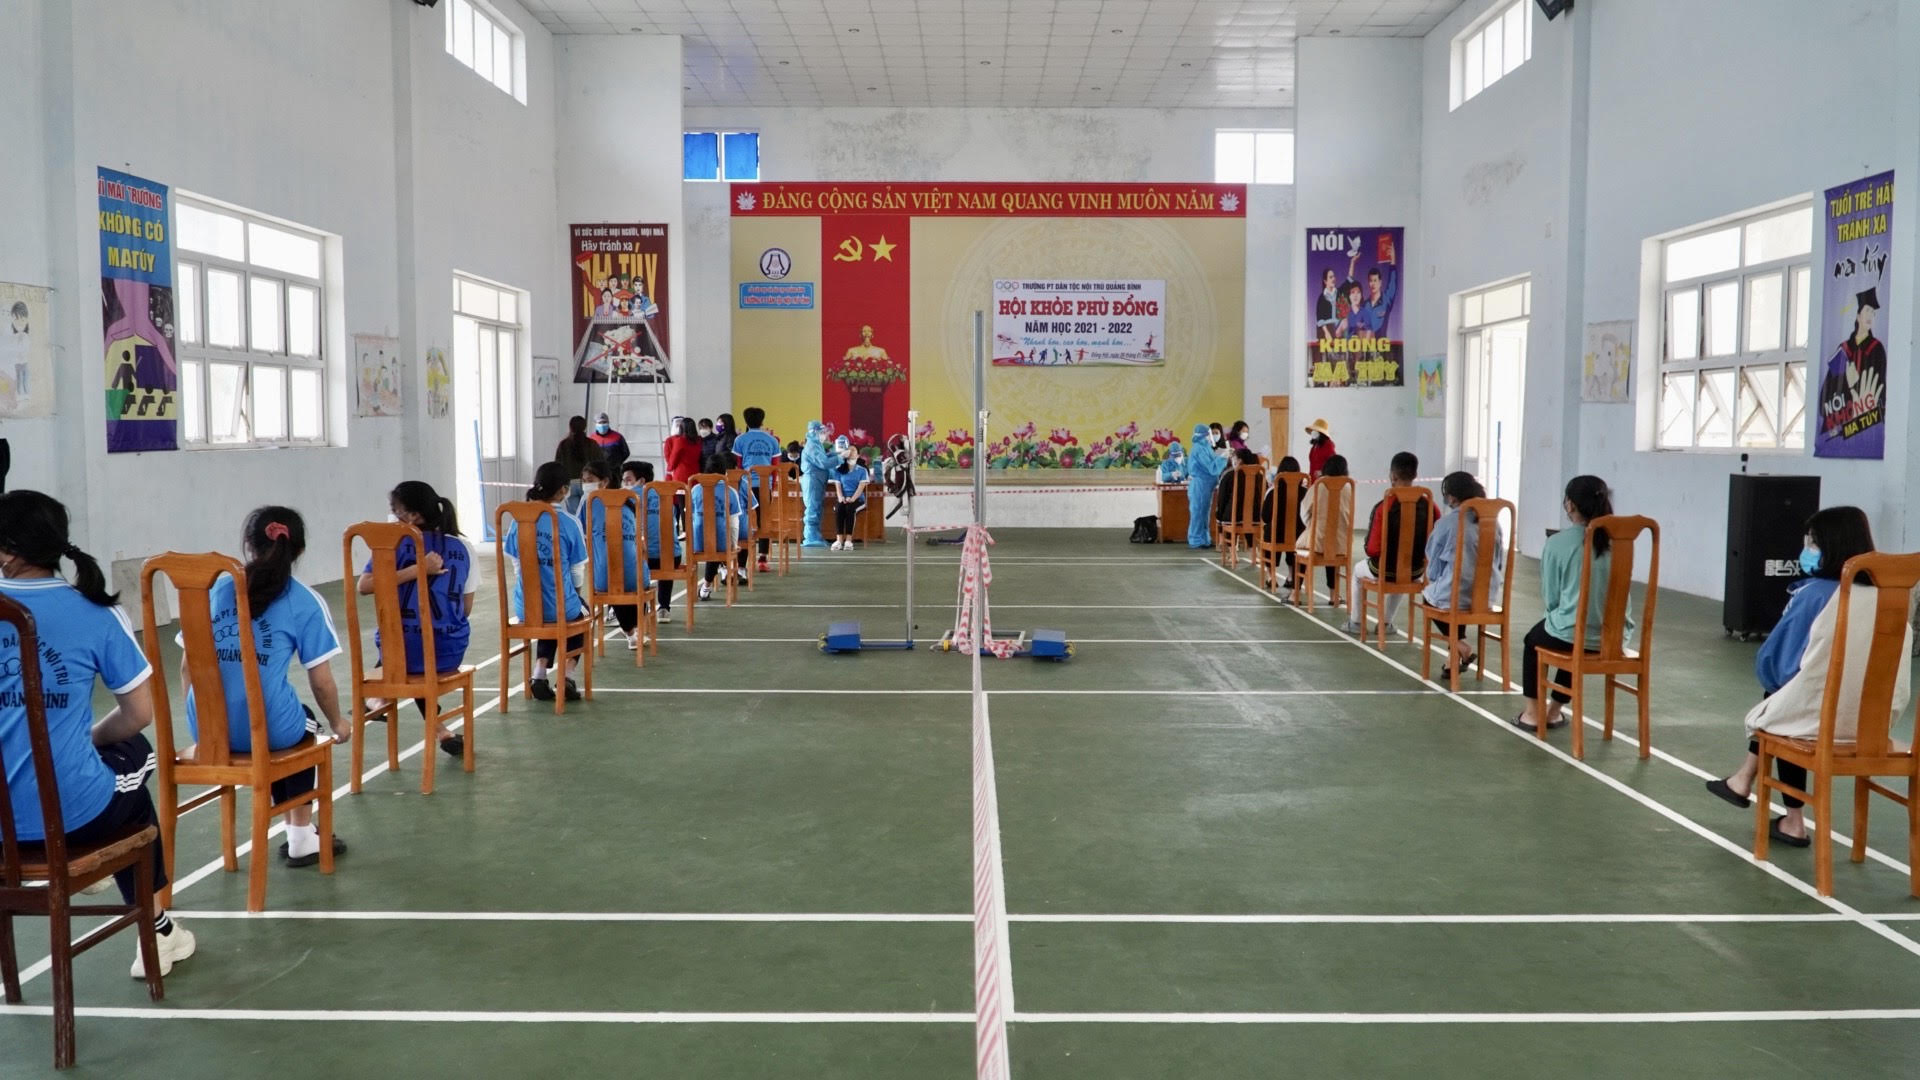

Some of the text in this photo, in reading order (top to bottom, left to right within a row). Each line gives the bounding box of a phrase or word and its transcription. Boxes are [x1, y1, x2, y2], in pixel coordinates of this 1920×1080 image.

[107, 180, 126, 201] MÁI
[762, 186, 1215, 213] ĐẢNG CỘNG SẢN VIỆT NAM QUANG VINH MUÔN NĂM
[1830, 188, 1852, 218] TUỔI
[1855, 183, 1873, 211] TRẺ
[99, 210, 164, 242] KHÔNG CÓ
[1837, 214, 1887, 243] TRÁNH XA
[581, 239, 633, 251] Hãy tránh xa
[1311, 230, 1344, 251] NÓI
[1834, 243, 1888, 282] ma túy
[1055, 282, 1068, 290] DÂN
[1069, 282, 1080, 291] TỘC
[1081, 282, 1092, 291] NỘI
[1105, 282, 1126, 291] QUẢNG
[998, 294, 1159, 319] HỘI KHỎE PHÙ ĐỔNG
[1025, 320, 1048, 333] NĂM
[1051, 322, 1071, 336] HỌC
[1074, 322, 1098, 333] 2021
[1108, 322, 1133, 333] 2022
[1319, 335, 1391, 352] KHÔNG
[1312, 360, 1350, 382] MA
[1824, 392, 1846, 416] NÓI
[1844, 421, 1859, 437] MA
[1764, 568, 1801, 576] BOX
[1765, 559, 1801, 568] BEAT
[221, 609, 230, 619] PT
[2, 633, 20, 648] DÂ
[42, 647, 63, 667] NỘI
[54, 665, 73, 686] TRÚ
[0, 684, 27, 711] UẢN
